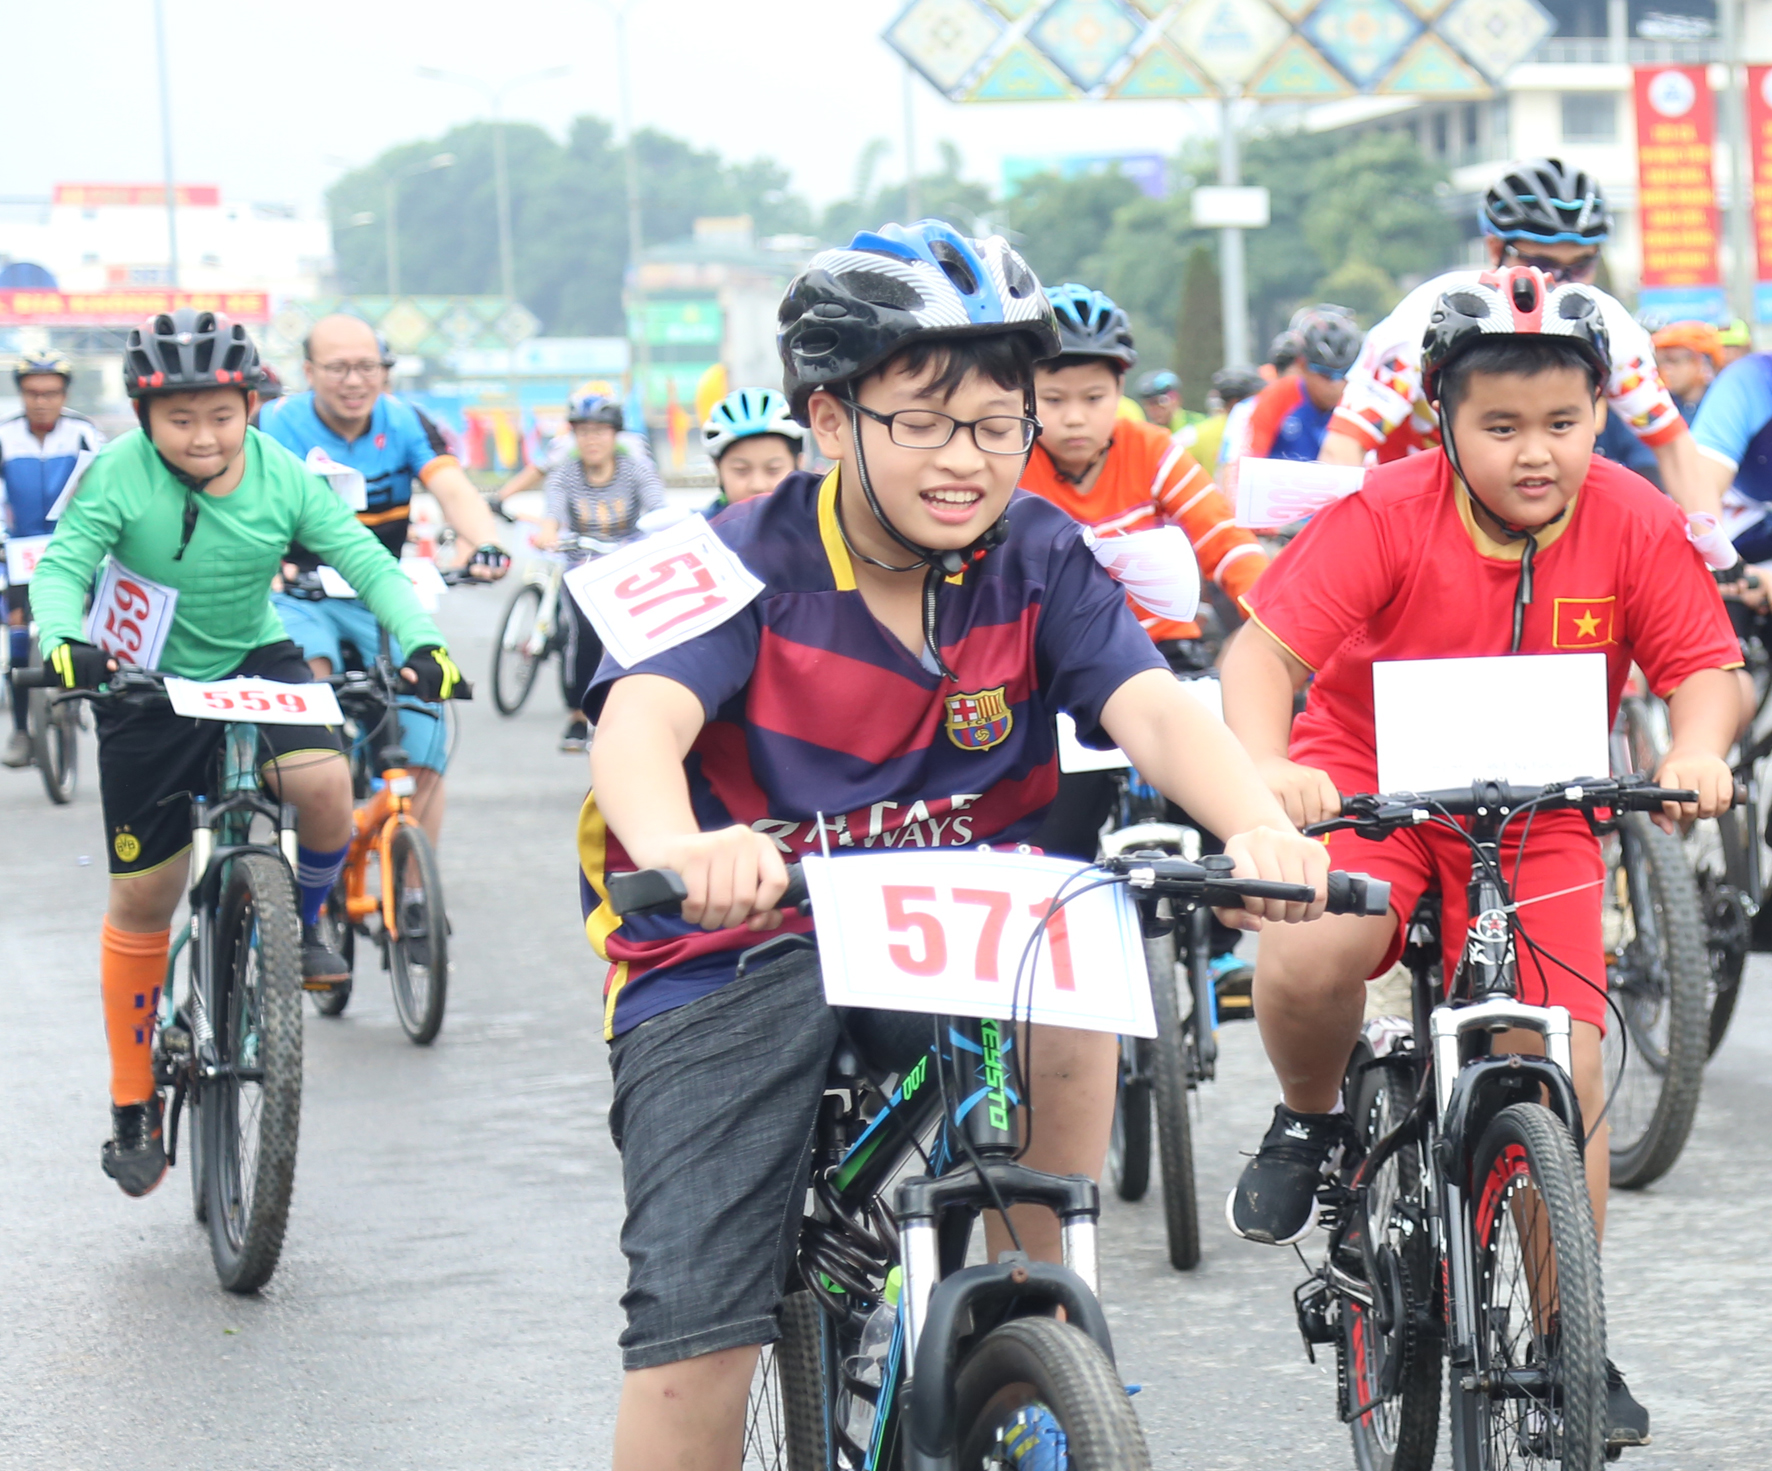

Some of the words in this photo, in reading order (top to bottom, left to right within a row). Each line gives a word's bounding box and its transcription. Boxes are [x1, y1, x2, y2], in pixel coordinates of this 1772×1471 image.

[614, 552, 728, 640] 571
[203, 690, 307, 714] 559
[966, 716, 992, 727] FCB
[881, 884, 1076, 992] 571
[902, 1055, 928, 1100] 007
